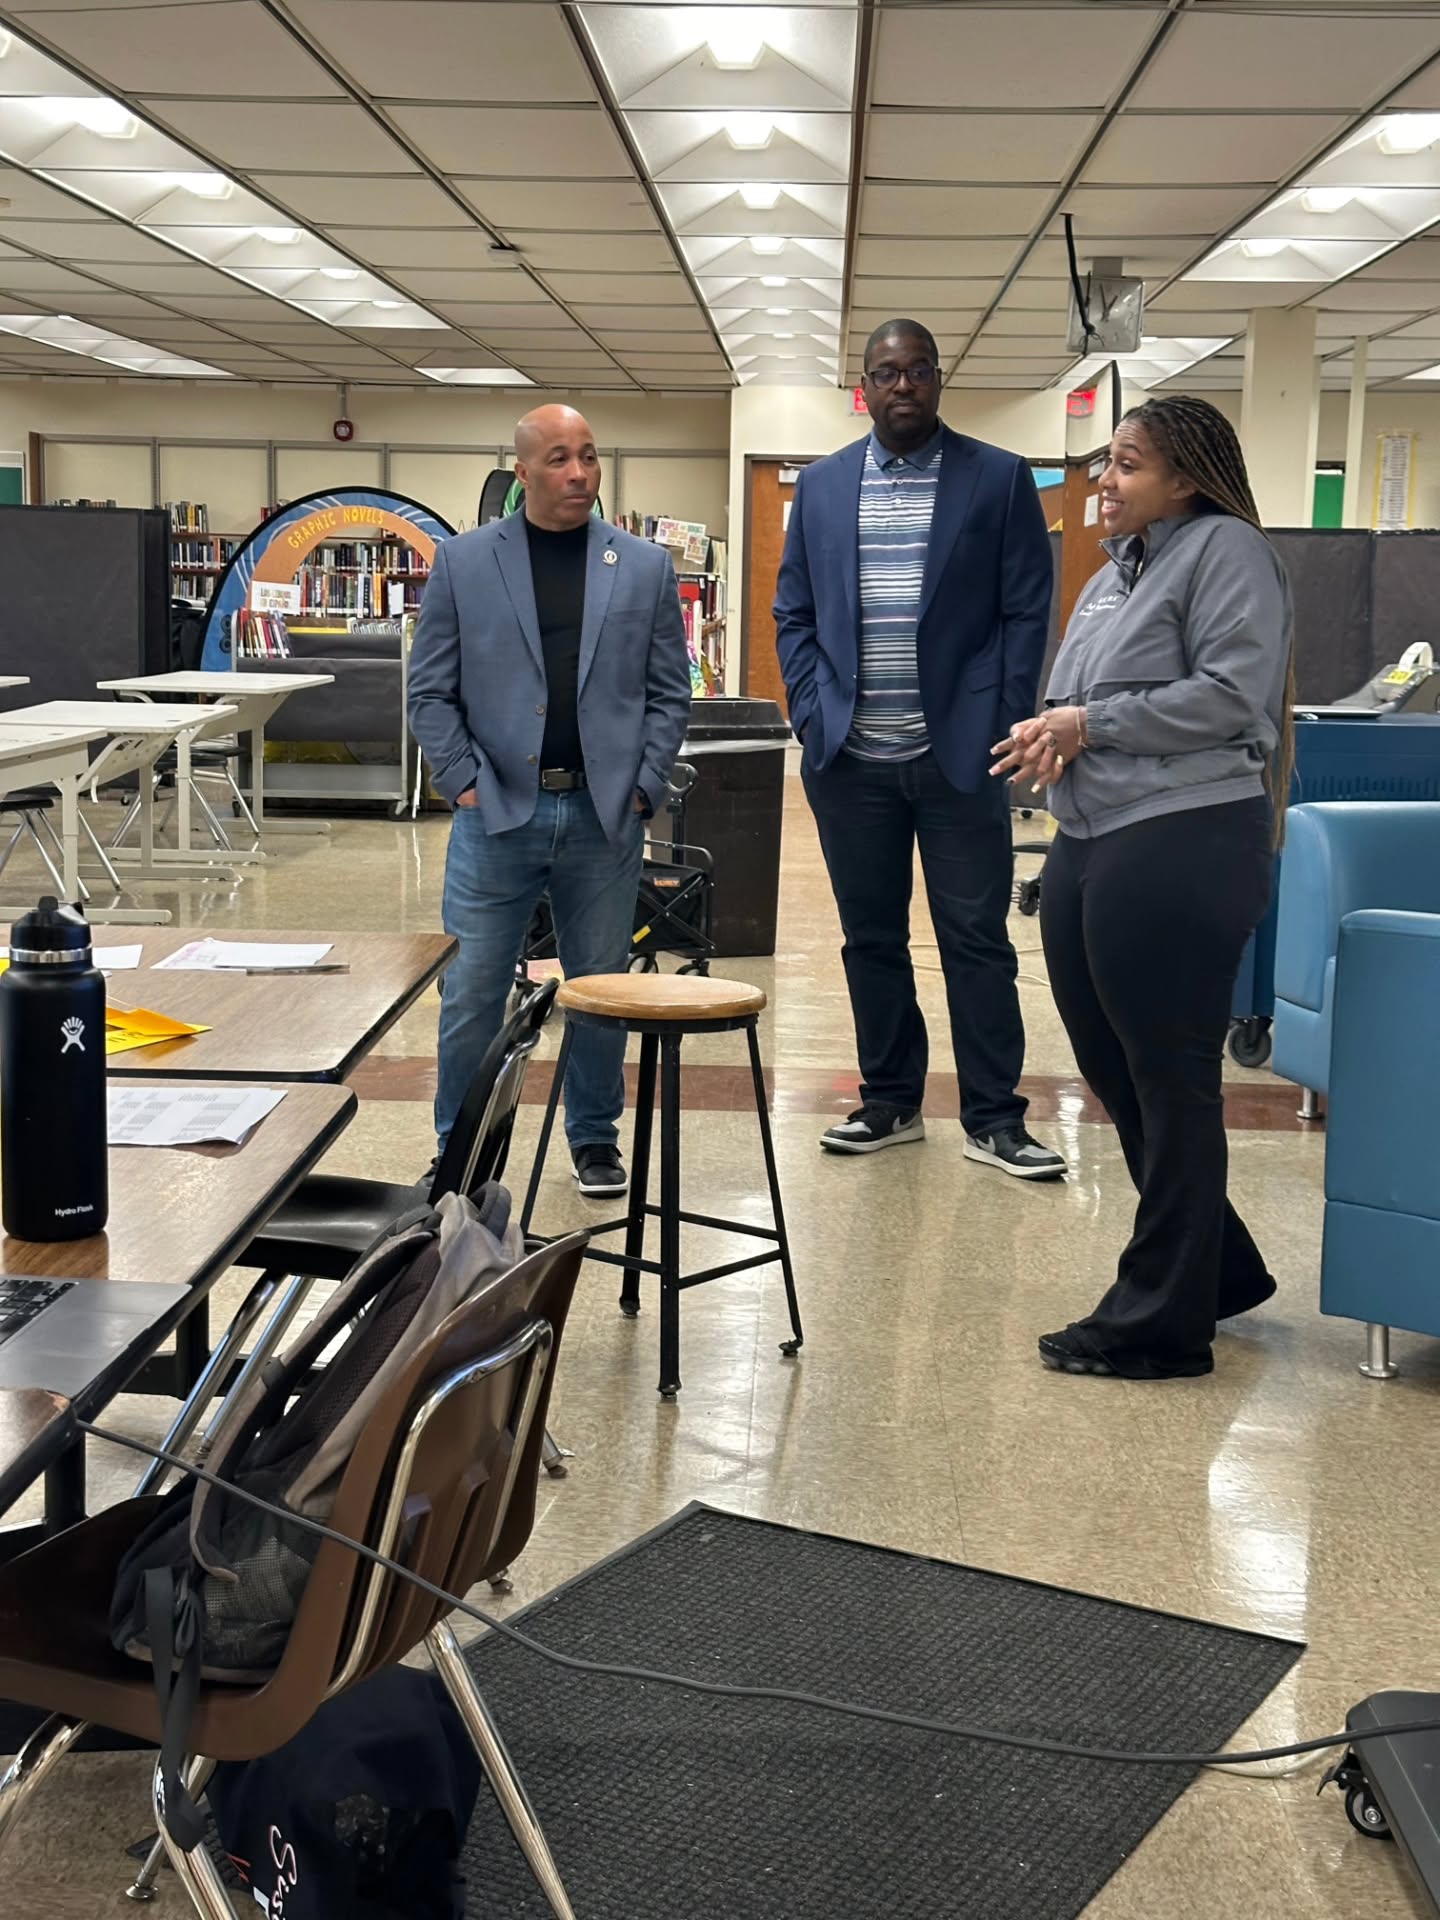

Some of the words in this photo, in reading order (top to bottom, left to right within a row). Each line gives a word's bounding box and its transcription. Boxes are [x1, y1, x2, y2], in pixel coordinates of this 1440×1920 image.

[287, 512, 337, 549] GRAPHIC
[343, 507, 384, 525] NOVELS
[54, 1207, 76, 1218] Hydro
[76, 1203, 94, 1213] Flask
[269, 1824, 298, 1920] Sis
